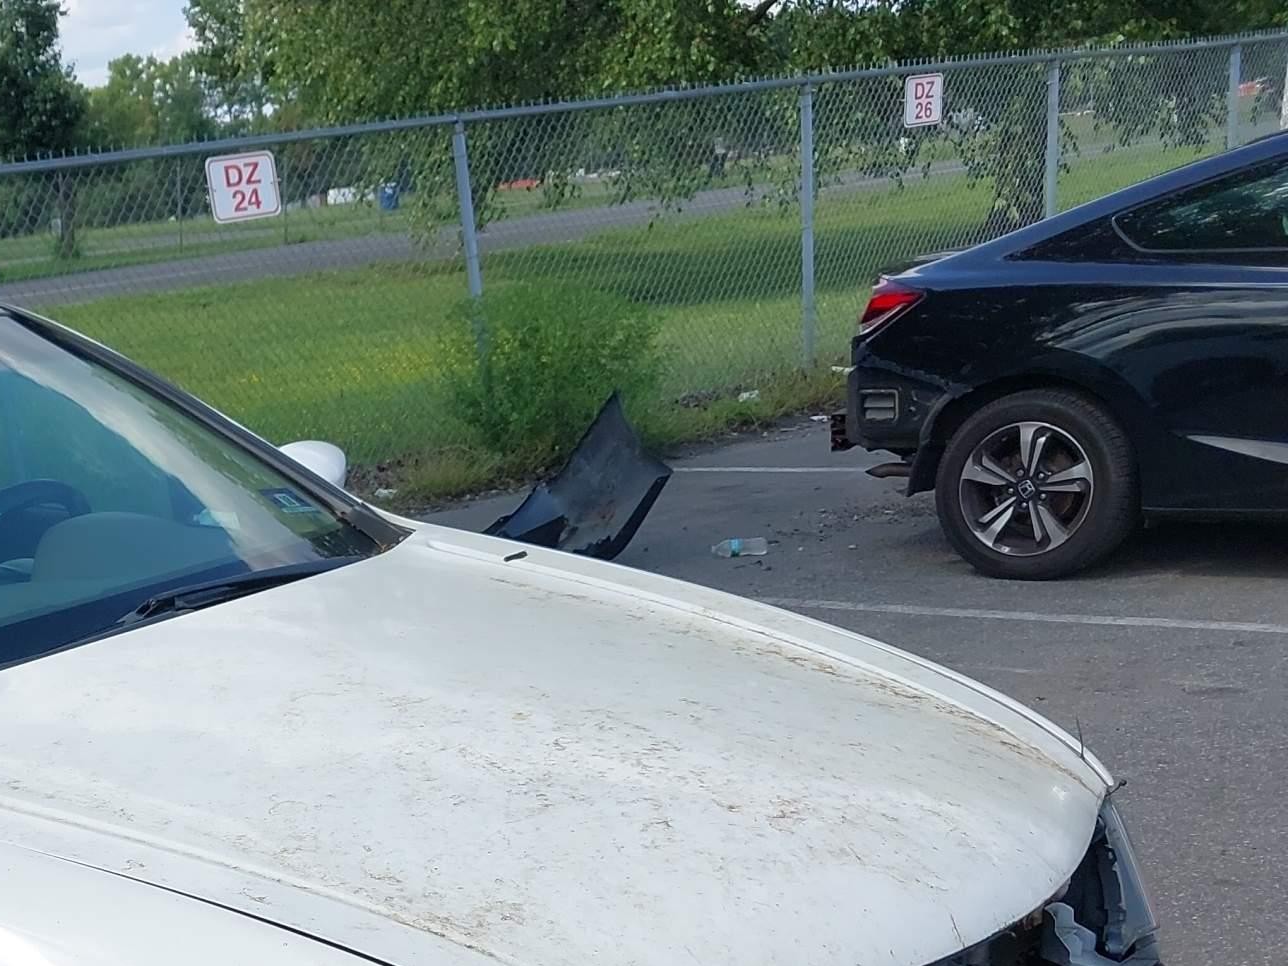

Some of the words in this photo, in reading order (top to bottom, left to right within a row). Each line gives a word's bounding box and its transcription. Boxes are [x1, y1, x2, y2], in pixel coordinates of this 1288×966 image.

[915, 81, 935, 100] DZ
[915, 101, 933, 119] 26
[224, 162, 261, 188] DZ
[232, 188, 261, 212] 24
